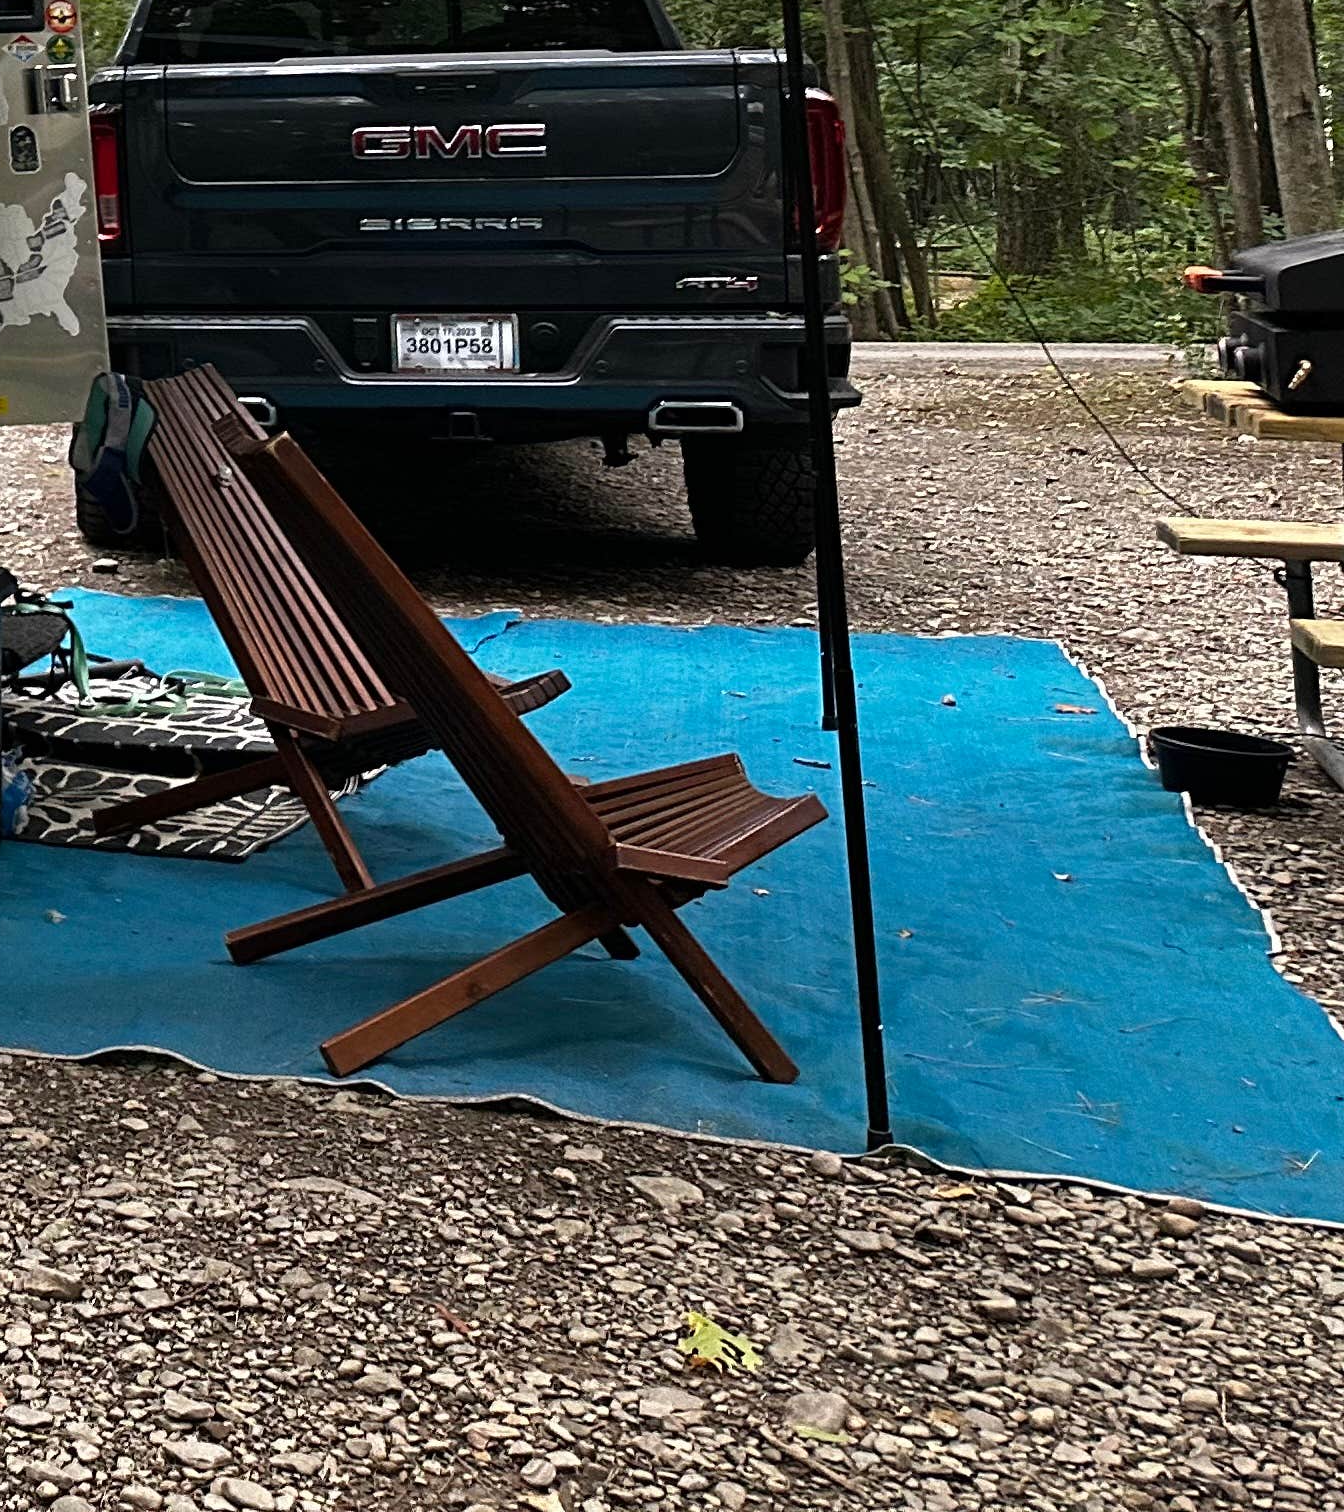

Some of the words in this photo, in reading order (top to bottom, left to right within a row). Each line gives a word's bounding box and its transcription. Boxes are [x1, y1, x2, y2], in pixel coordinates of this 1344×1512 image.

[352, 124, 547, 160] GMC
[360, 217, 544, 231] SIERRA
[421, 328, 440, 336] OCT
[406, 338, 493, 354] 3801P58
